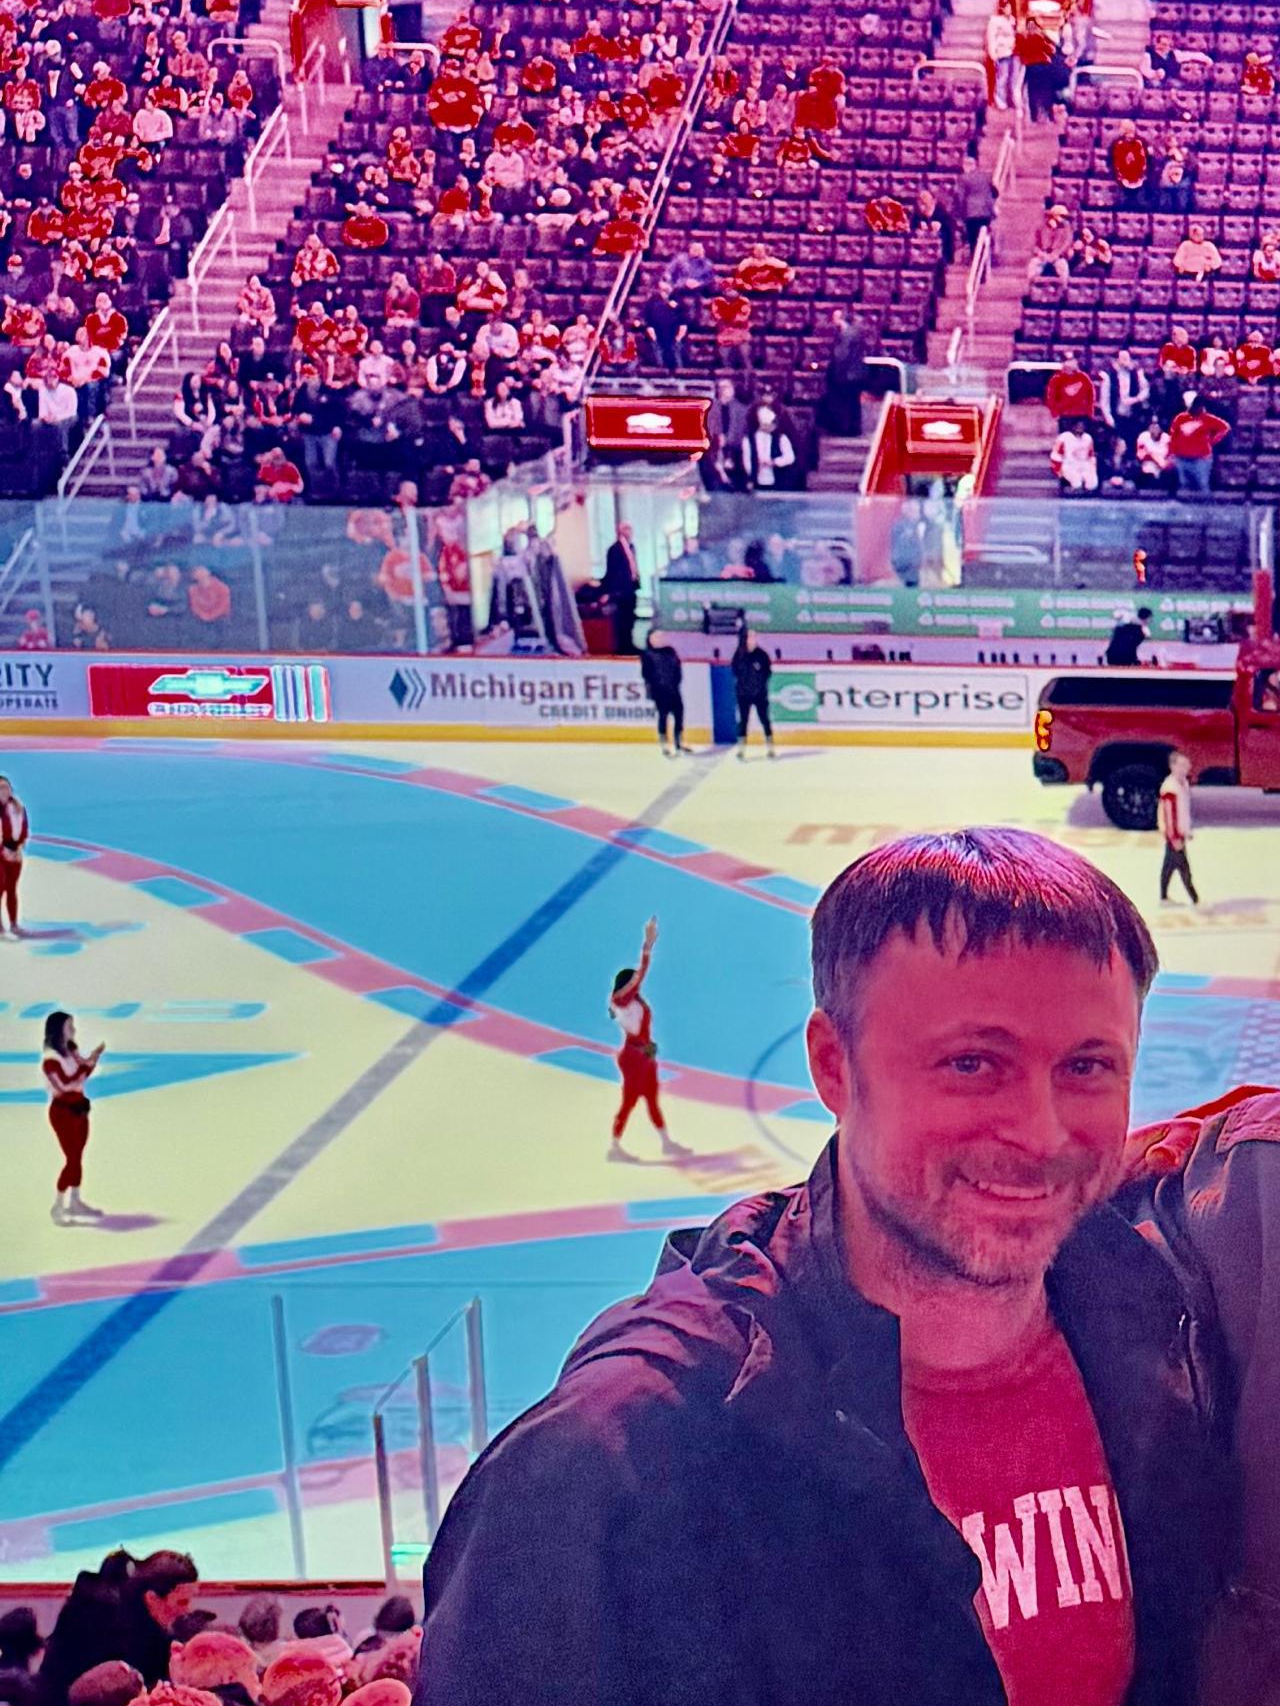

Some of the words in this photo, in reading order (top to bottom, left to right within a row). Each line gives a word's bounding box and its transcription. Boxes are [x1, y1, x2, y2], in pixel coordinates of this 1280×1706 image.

[0, 663, 54, 687] ITY
[430, 672, 575, 706] Michigan
[538, 704, 599, 718] CREDIT
[776, 684, 1025, 716] enterprise
[961, 1484, 1123, 1630] WIN
